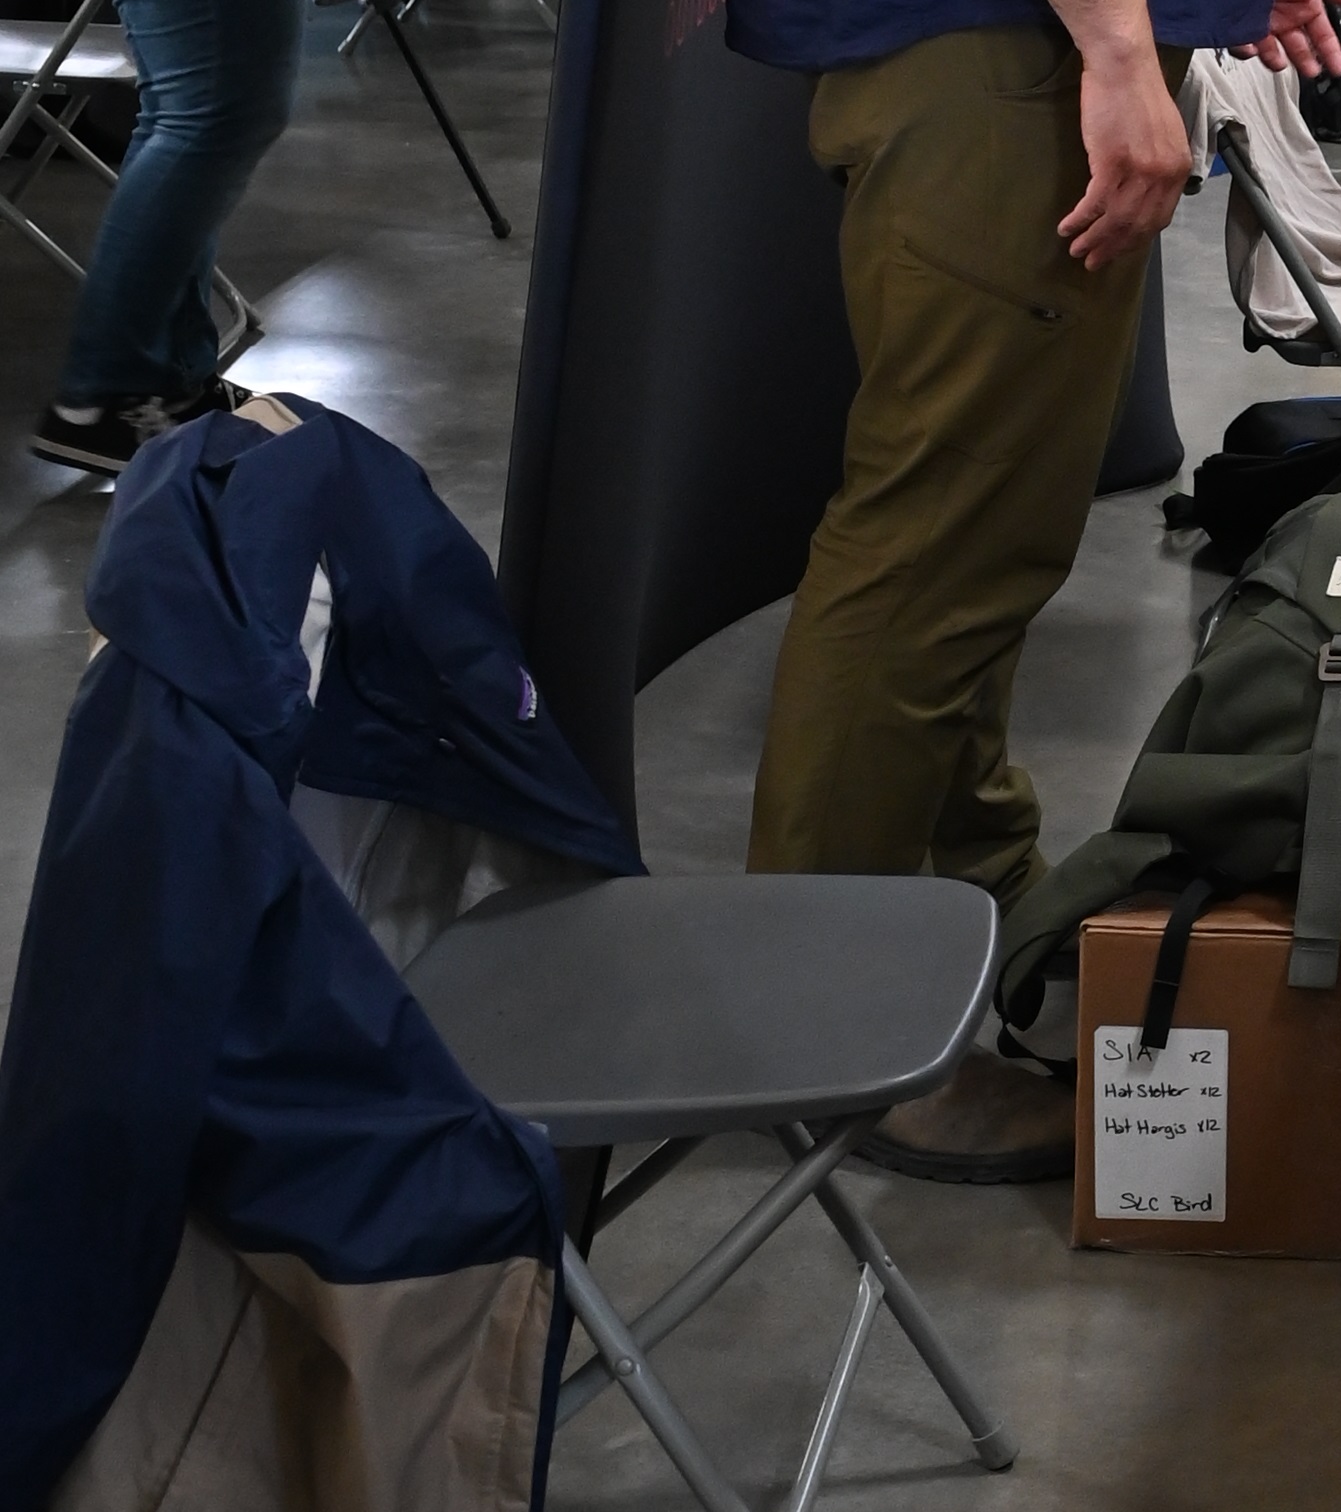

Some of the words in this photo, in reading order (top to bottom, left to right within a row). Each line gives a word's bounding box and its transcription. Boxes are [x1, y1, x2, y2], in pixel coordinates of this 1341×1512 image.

[1105, 1083, 1133, 1098] Hat
[1105, 1117, 1132, 1134] Hat
[1119, 1193, 1160, 1212] SLC
[1171, 1192, 1212, 1212] Bird
